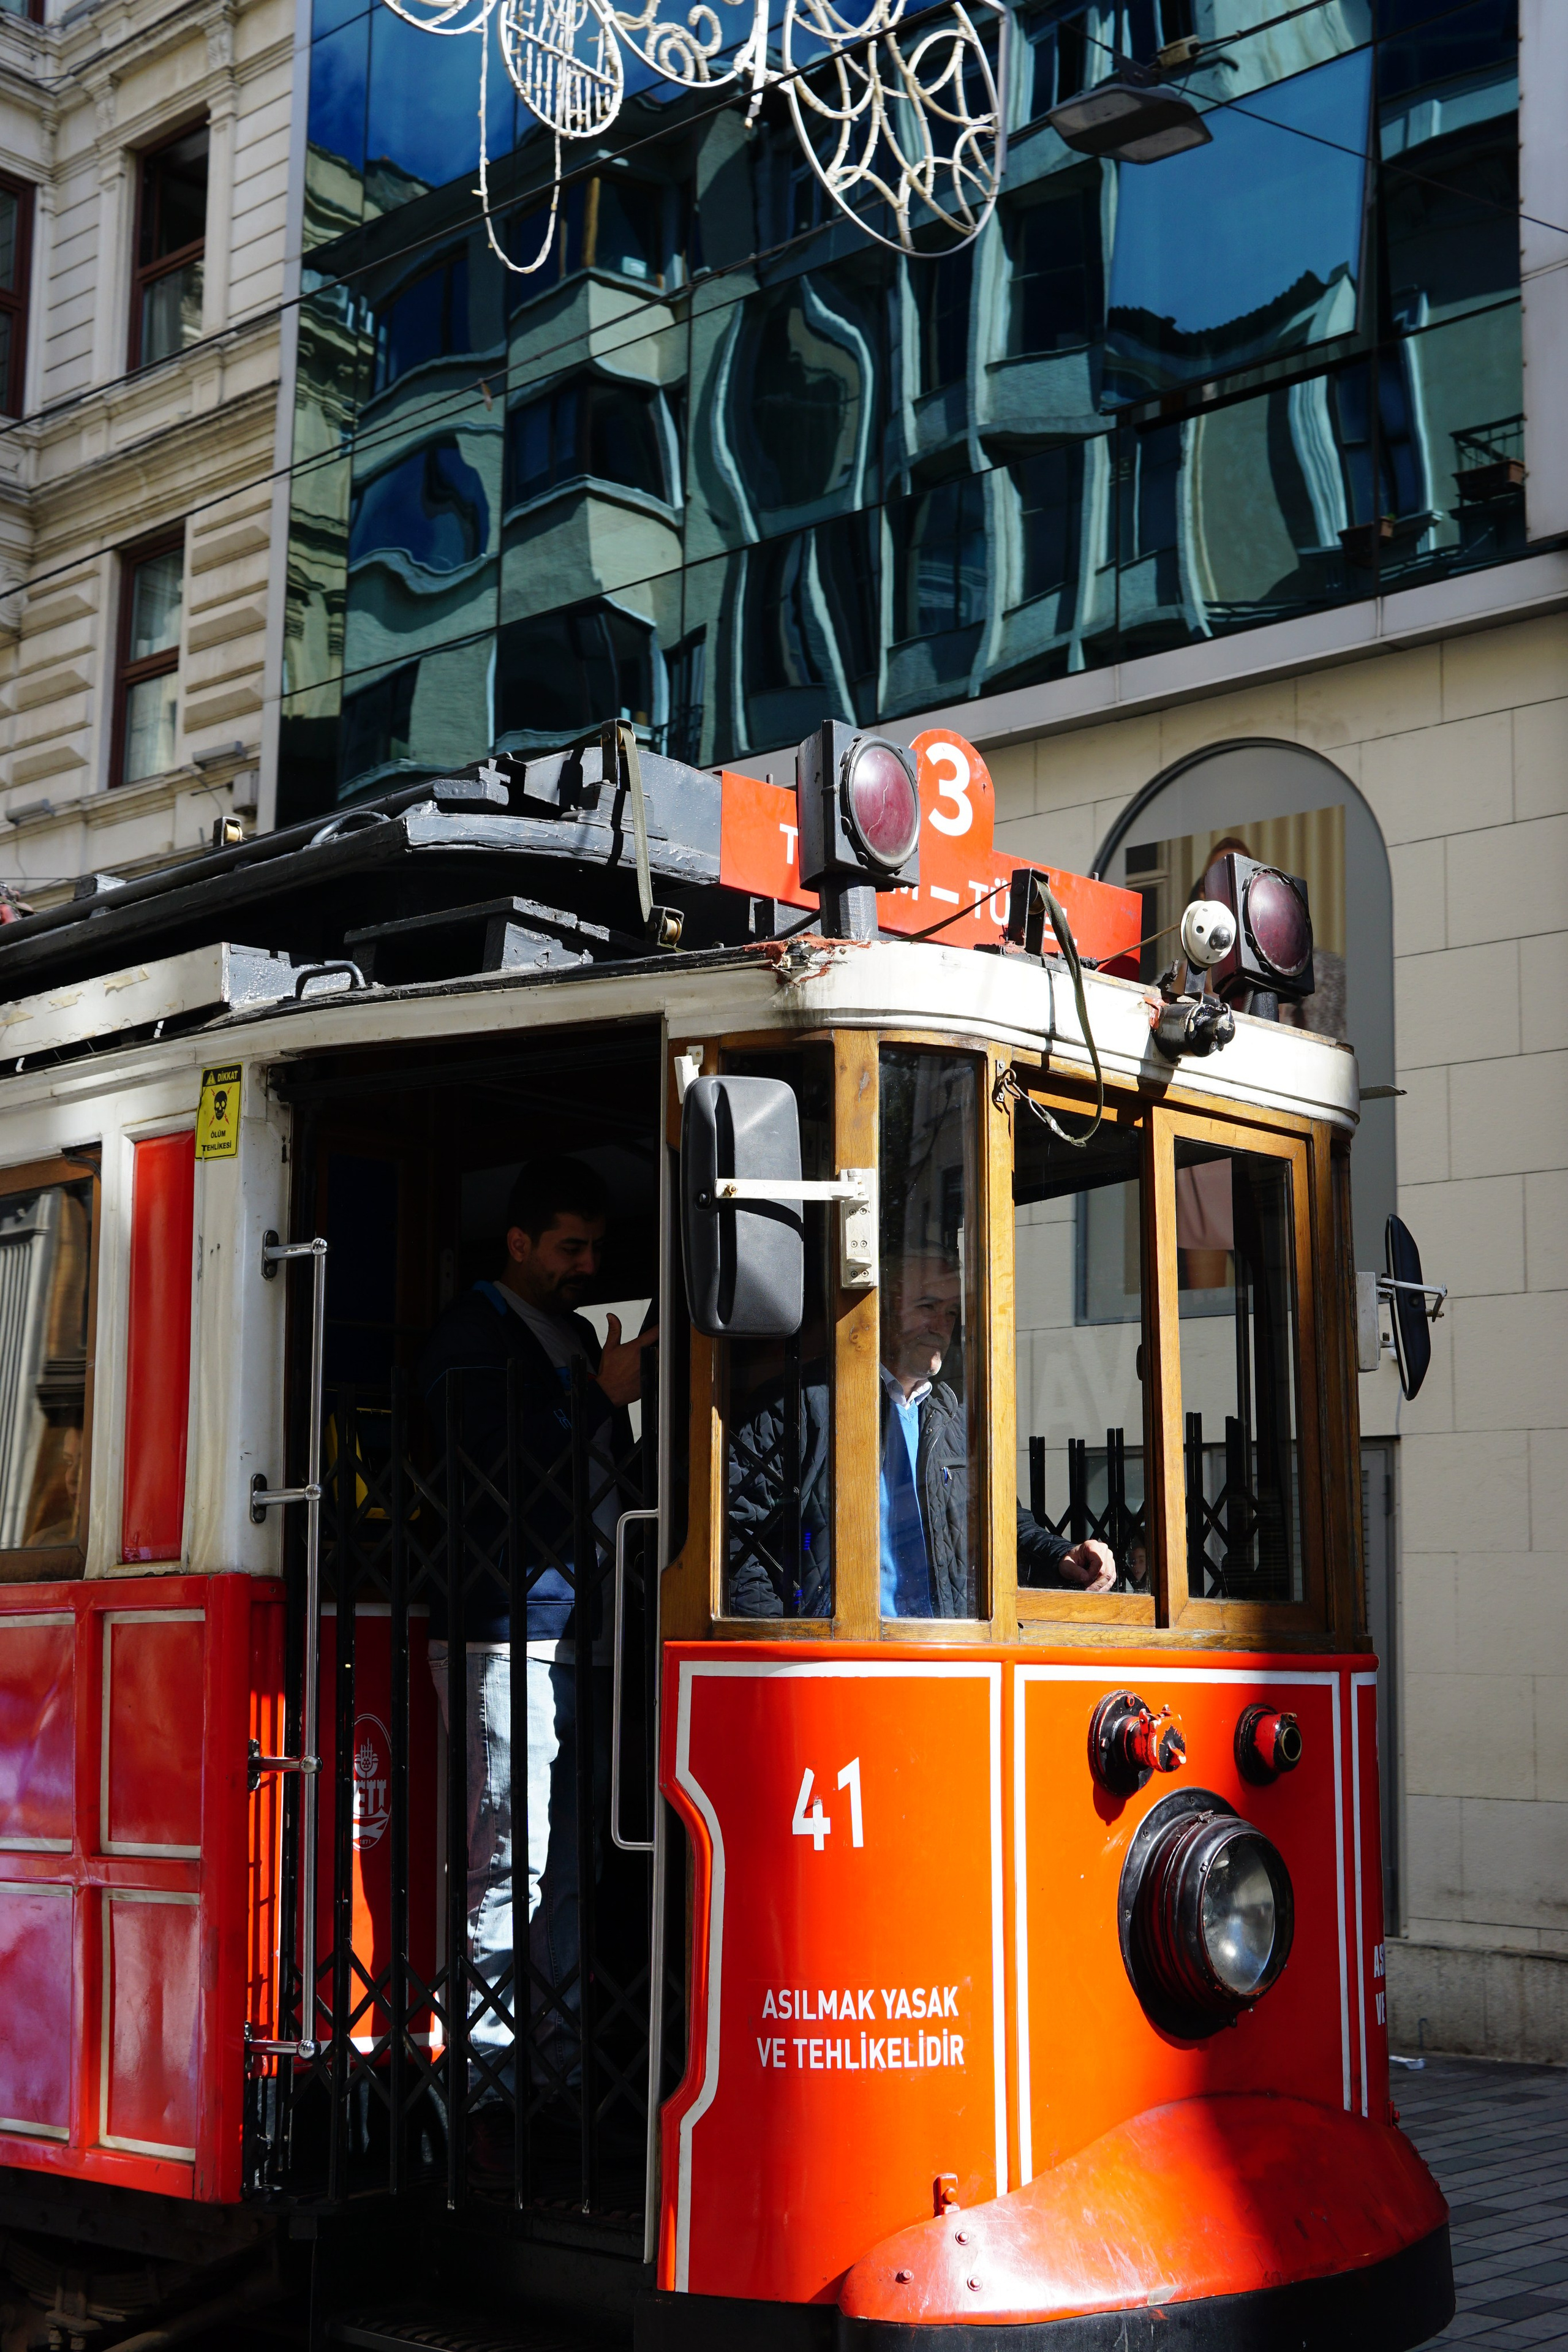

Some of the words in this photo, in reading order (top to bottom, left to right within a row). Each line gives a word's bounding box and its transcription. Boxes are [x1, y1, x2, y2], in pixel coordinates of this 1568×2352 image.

[925, 742, 973, 836] 3
[217, 1071, 238, 1082] DİKKAT
[202, 1140, 232, 1152] TEHLİKESİ
[211, 1130, 226, 1139] ÖLÜM
[353, 1779, 386, 1815] ETT
[792, 1757, 864, 1851] 41
[761, 1988, 876, 2020] ASILMAK
[881, 1986, 959, 2019] YASAK
[756, 2037, 786, 2068] VE
[793, 2028, 965, 2069] TEHLİKELİDİR
